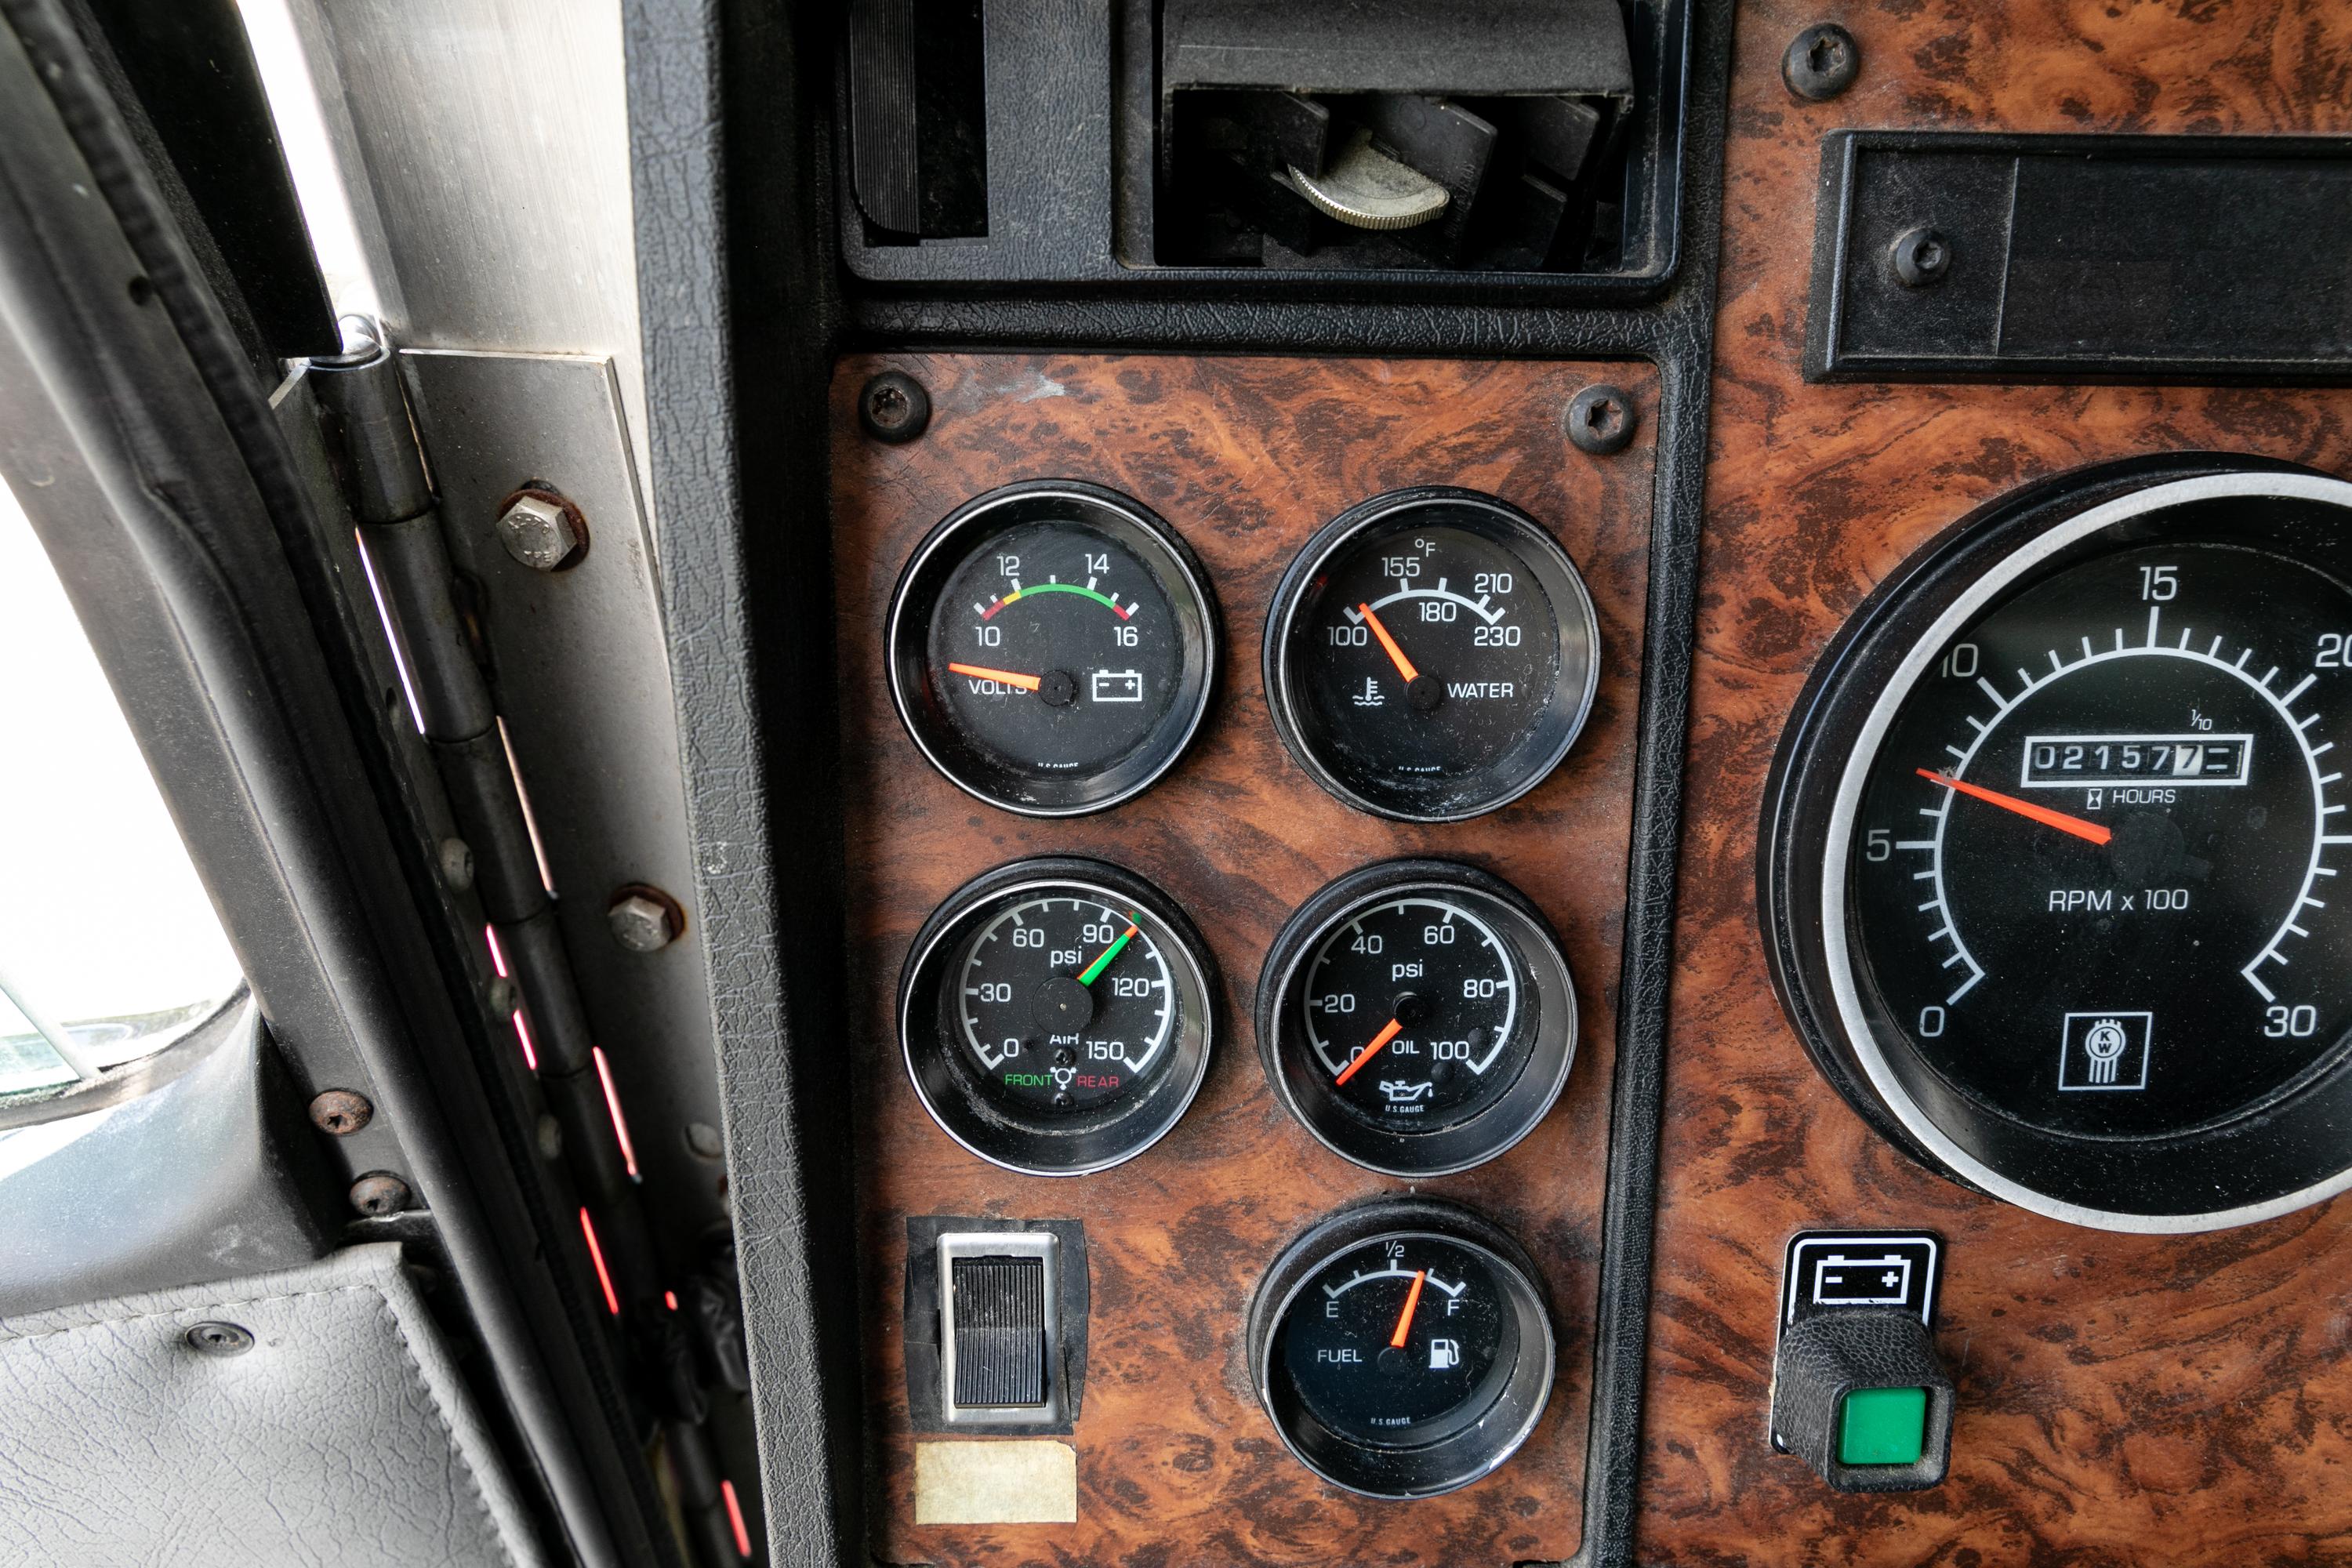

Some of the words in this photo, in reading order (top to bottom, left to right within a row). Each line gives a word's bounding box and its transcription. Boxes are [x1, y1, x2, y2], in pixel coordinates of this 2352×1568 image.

[996, 555, 1020, 576] 12
[1084, 553, 1110, 575] 14
[1381, 556, 1421, 578] 155
[1474, 573, 1512, 593] 210
[2140, 565, 2178, 601] 15
[1417, 601, 1457, 622] 180
[975, 626, 1001, 647] 10
[1113, 626, 1138, 647] 16
[1326, 626, 1368, 648] 100
[1474, 626, 1521, 647] 230
[1940, 642, 1979, 678] 10
[1446, 682, 1514, 699] WATER
[2190, 709, 2212, 731] 1/10
[2112, 789, 2176, 804] HOURS
[1866, 829, 1890, 862] 5
[2049, 889, 2112, 912] RPM
[2144, 889, 2189, 910] 100
[1011, 927, 1045, 949] 60
[1083, 924, 1114, 944] 90
[1351, 935, 1383, 954] 40
[1424, 924, 1455, 945] 60
[1049, 945, 1083, 968] psi
[1391, 958, 1424, 982] psi
[980, 982, 1011, 1003] 30
[1111, 977, 1150, 997] 120
[1463, 978, 1495, 999] 80
[1324, 993, 1356, 1013] 20
[1918, 1006, 1945, 1037] 0
[2263, 1004, 2317, 1037] 30
[1004, 1038, 1019, 1058] 0
[1049, 1033, 1080, 1045] AIR
[1392, 1040, 1420, 1054] OIL
[1085, 1040, 1124, 1061] 150
[1349, 1045, 1366, 1065] 0
[1429, 1040, 1470, 1061] 100
[1005, 1073, 1054, 1087] FRONT
[1077, 1075, 1120, 1088] REAR
[1326, 1301, 1339, 1319] E
[1447, 1298, 1461, 1316] F
[1317, 1348, 1363, 1363] FUEL
